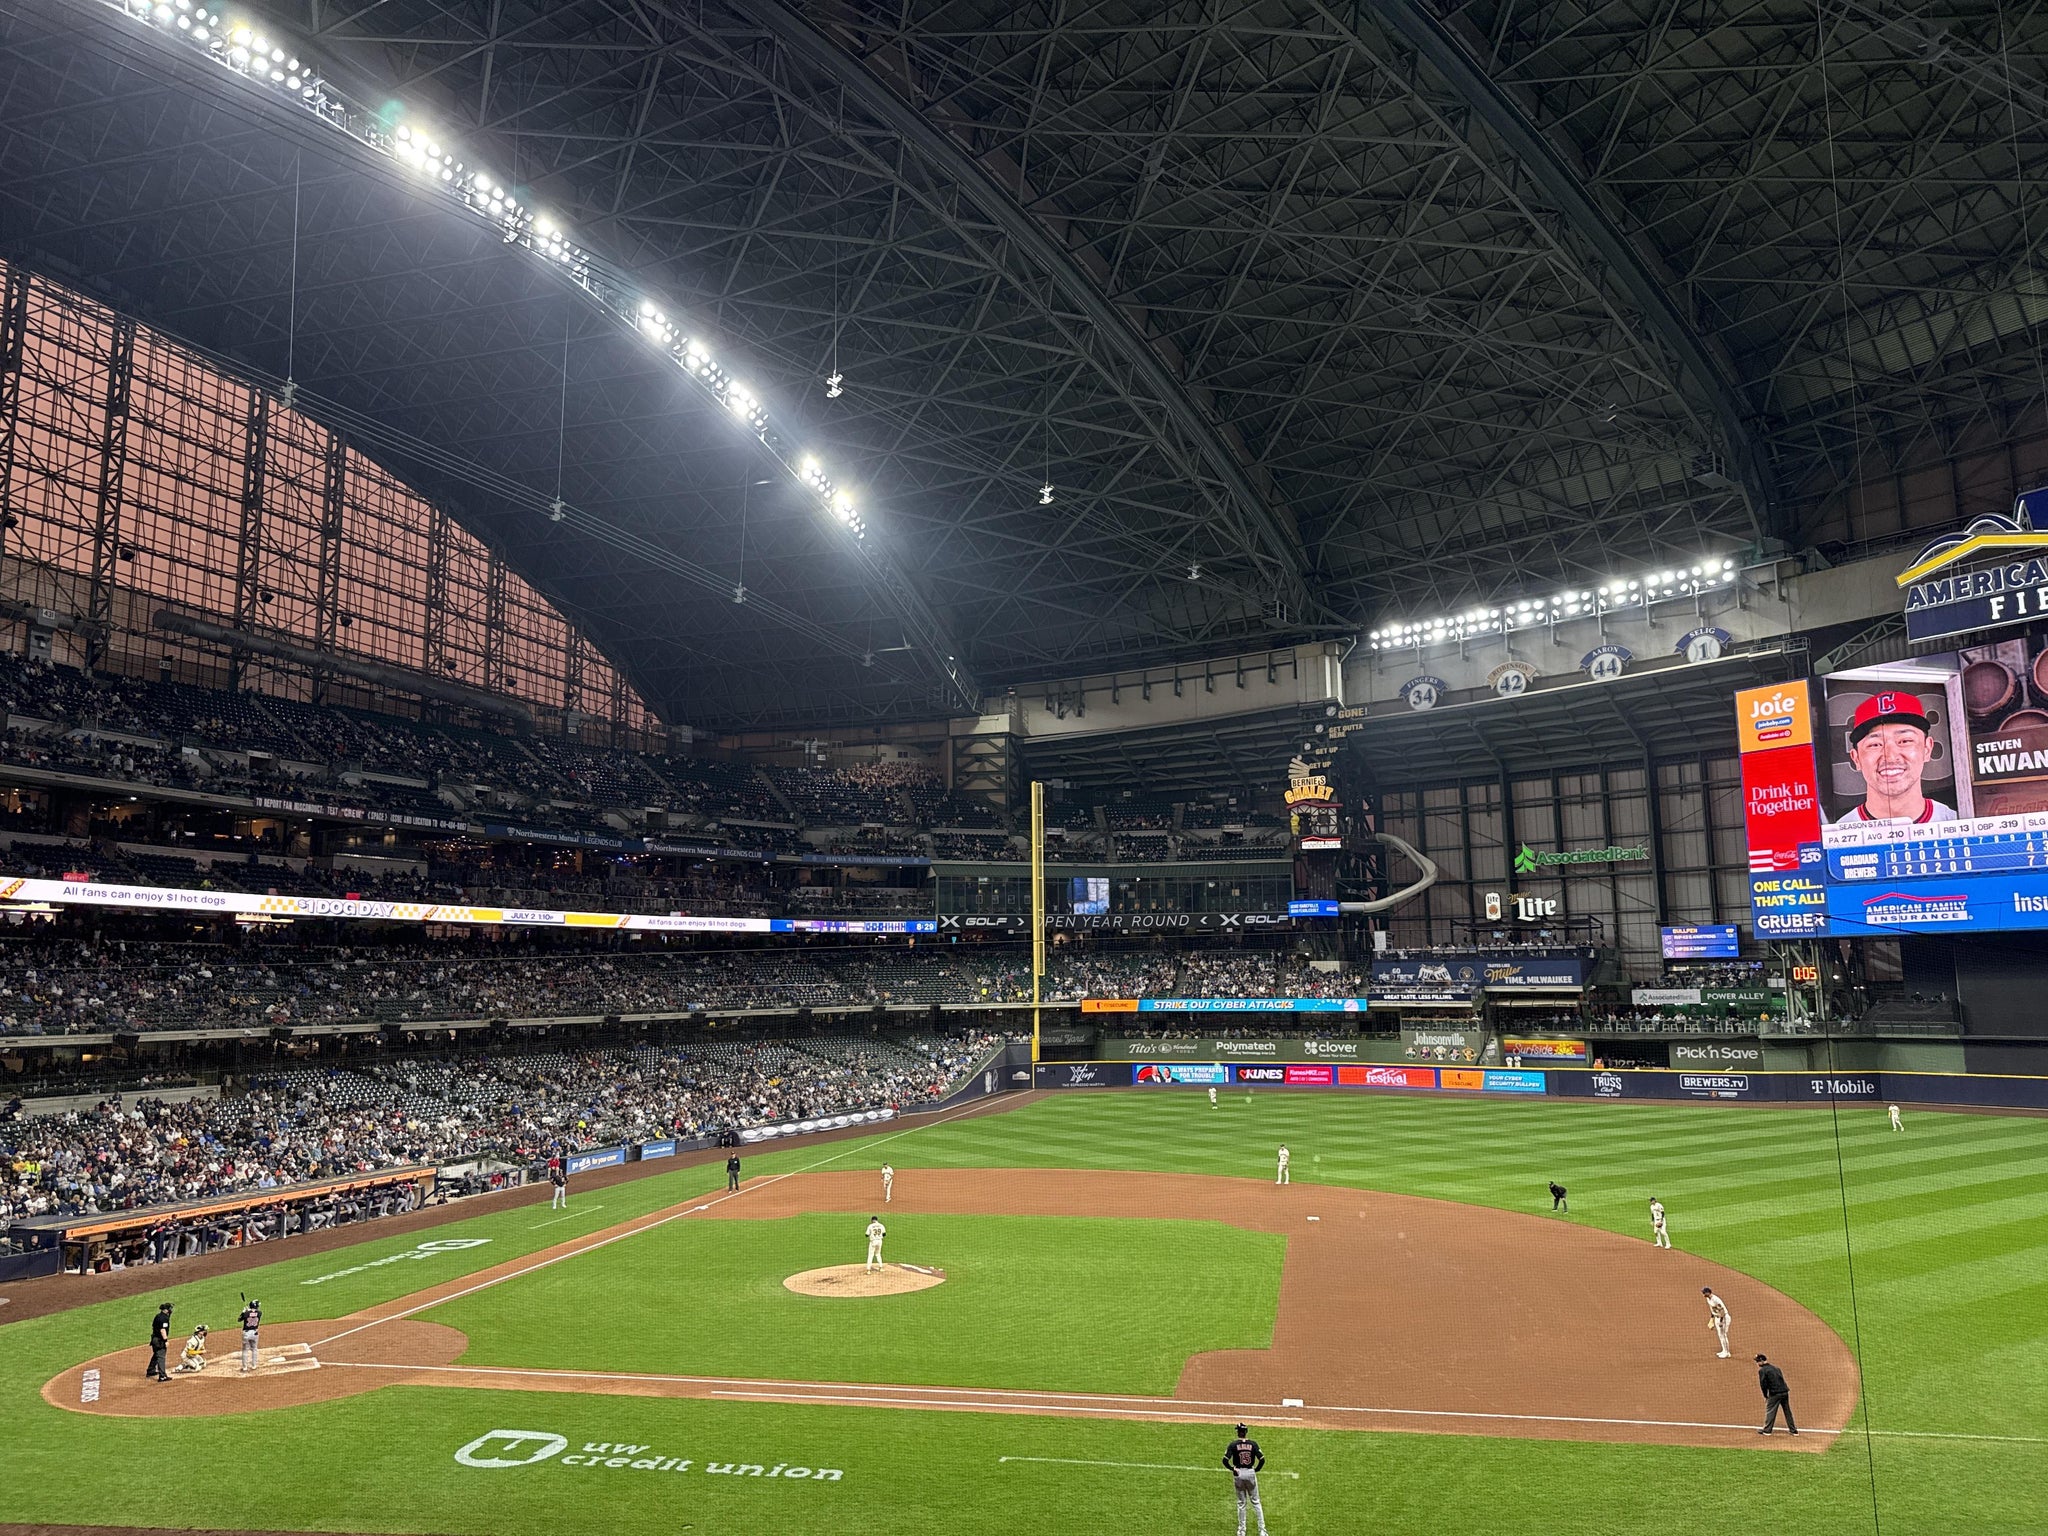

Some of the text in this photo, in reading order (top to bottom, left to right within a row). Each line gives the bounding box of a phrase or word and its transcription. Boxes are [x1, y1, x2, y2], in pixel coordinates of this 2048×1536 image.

[1689, 627, 1716, 639] SELIG
[1592, 646, 1619, 658] AARON
[1699, 642, 1709, 661] 1
[1492, 662, 1529, 676] ROBINSON
[1594, 658, 1618, 677] 44
[1407, 676, 1438, 689] FINGERS
[1500, 674, 1522, 692] 42
[1412, 688, 1434, 706] 34
[1877, 692, 1896, 714] C
[1750, 692, 1795, 718] Joie
[1338, 707, 1368, 719] GONE!
[1976, 738, 2022, 753] STEVEN
[1292, 776, 1326, 787] BERNIE'S
[1285, 785, 1334, 804] CHALET
[1752, 781, 1808, 801] Drink in
[1748, 797, 1814, 817] Together
[1839, 819, 1892, 831] SEASON STATS
[1841, 834, 1858, 843] 277
[1887, 830, 1905, 839] .210
[1913, 829, 1925, 837] HR
[1959, 824, 1970, 832] 13
[1977, 822, 1994, 831] OBP
[1999, 820, 2018, 829] .319
[2028, 818, 2046, 826] SLG
[515, 829, 580, 843] Northwestern Mutual
[584, 837, 609, 846] LEGENDS
[653, 844, 718, 855] Northwestern Mutual
[723, 849, 748, 858] LEGENDS
[1774, 850, 1797, 860] Coca-Cola
[1840, 841, 2034, 866] GUARDIANS 0 0 0 4 0 0 4
[1800, 852, 1822, 864] 250
[1844, 855, 2035, 879] BREWERS 3 2 0 2 0 0 7
[1753, 878, 1823, 892] ONE CALL...
[63, 886, 79, 896] All
[82, 887, 108, 898] fans
[110, 890, 131, 899] can
[134, 891, 163, 903] enjoy
[180, 893, 198, 903] hot
[200, 895, 226, 906] dogs
[1754, 892, 1825, 908] THAT'S ALL!
[297, 899, 396, 918] $1 DOG DAY
[1517, 897, 1557, 922] Lite
[1866, 900, 1967, 915] AMERICAN FAMILY
[510, 912, 530, 920] JULY
[940, 915, 1008, 928] X GOLF
[1083, 914, 1190, 928] YEAR ROUND
[1219, 914, 1289, 926] X GOLF
[1757, 912, 1826, 929] GRUBER
[1874, 912, 1960, 922] INSURANCE
[688, 920, 706, 928] enjoy
[916, 923, 934, 931] 8:29
[1484, 966, 1524, 984] Miller
[1504, 975, 1573, 985] TIME, MILWAUKEE
[1793, 966, 1818, 981] 0:05
[1706, 992, 1765, 1000] POWER ALLEY
[1153, 1000, 1295, 1010] STRIKE OUT CYBER ATTACKS
[1064, 1034, 1086, 1045] Yard
[1216, 1041, 1276, 1051] Polymatech
[1413, 1032, 1465, 1046] Johnsonville
[1129, 1043, 1157, 1054] Tito's
[1318, 1041, 1358, 1052] clover
[1512, 1042, 1553, 1056] Surfside
[1721, 1047, 1759, 1060] Save
[1246, 1069, 1283, 1080] KUNES
[1366, 1069, 1407, 1086] festival
[1592, 1077, 1622, 1091] TRUSS
[1826, 1080, 1875, 1094] Mobile
[582, 1442, 650, 1455] uw
[561, 1454, 844, 1481] credit union
